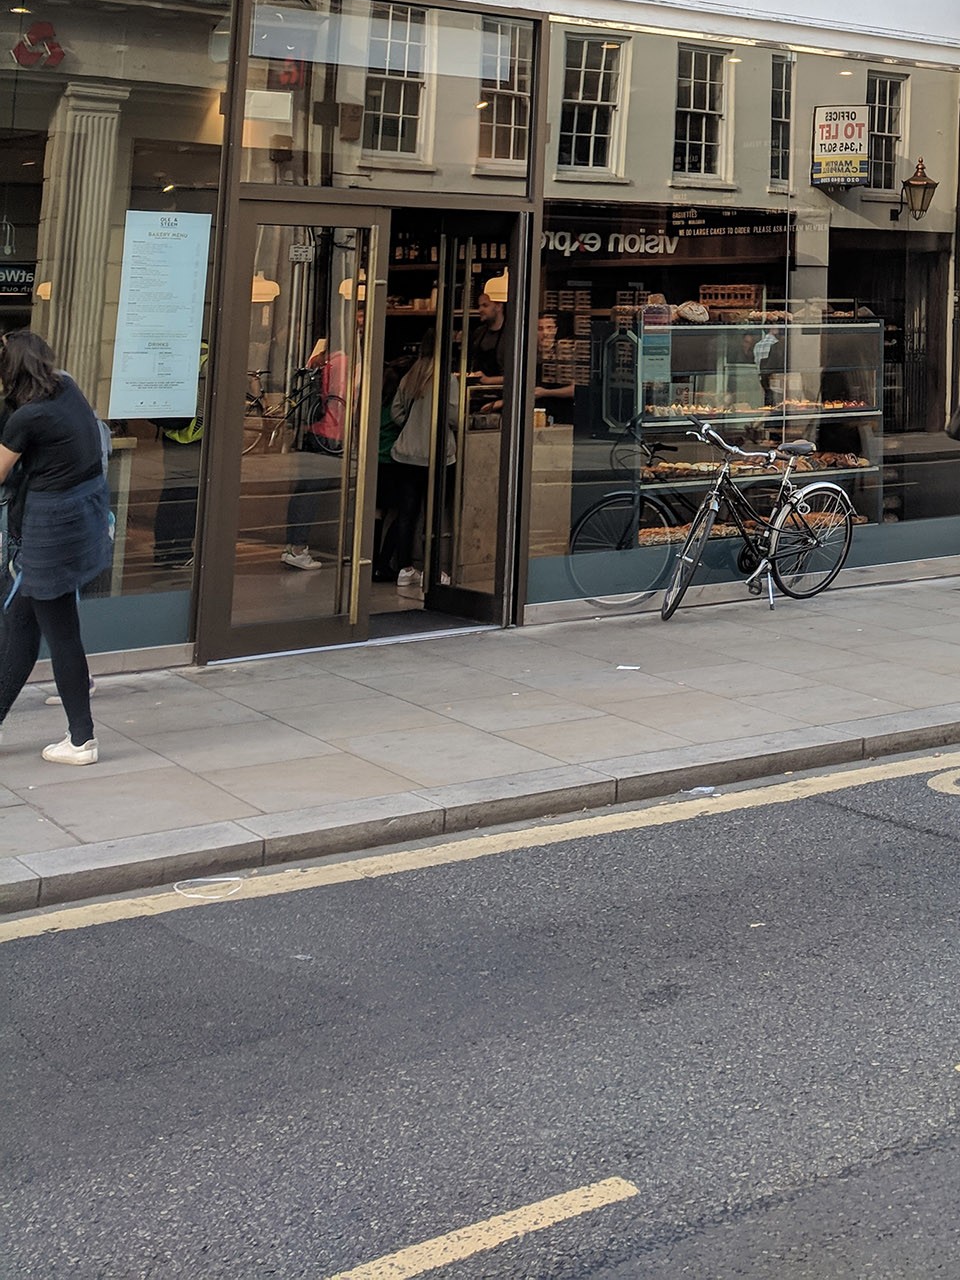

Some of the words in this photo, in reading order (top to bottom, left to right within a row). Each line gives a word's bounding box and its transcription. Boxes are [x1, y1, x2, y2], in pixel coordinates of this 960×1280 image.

[693, 228, 709, 236] LARGE
[709, 227, 726, 235] CAKES
[734, 226, 750, 234] ORDER
